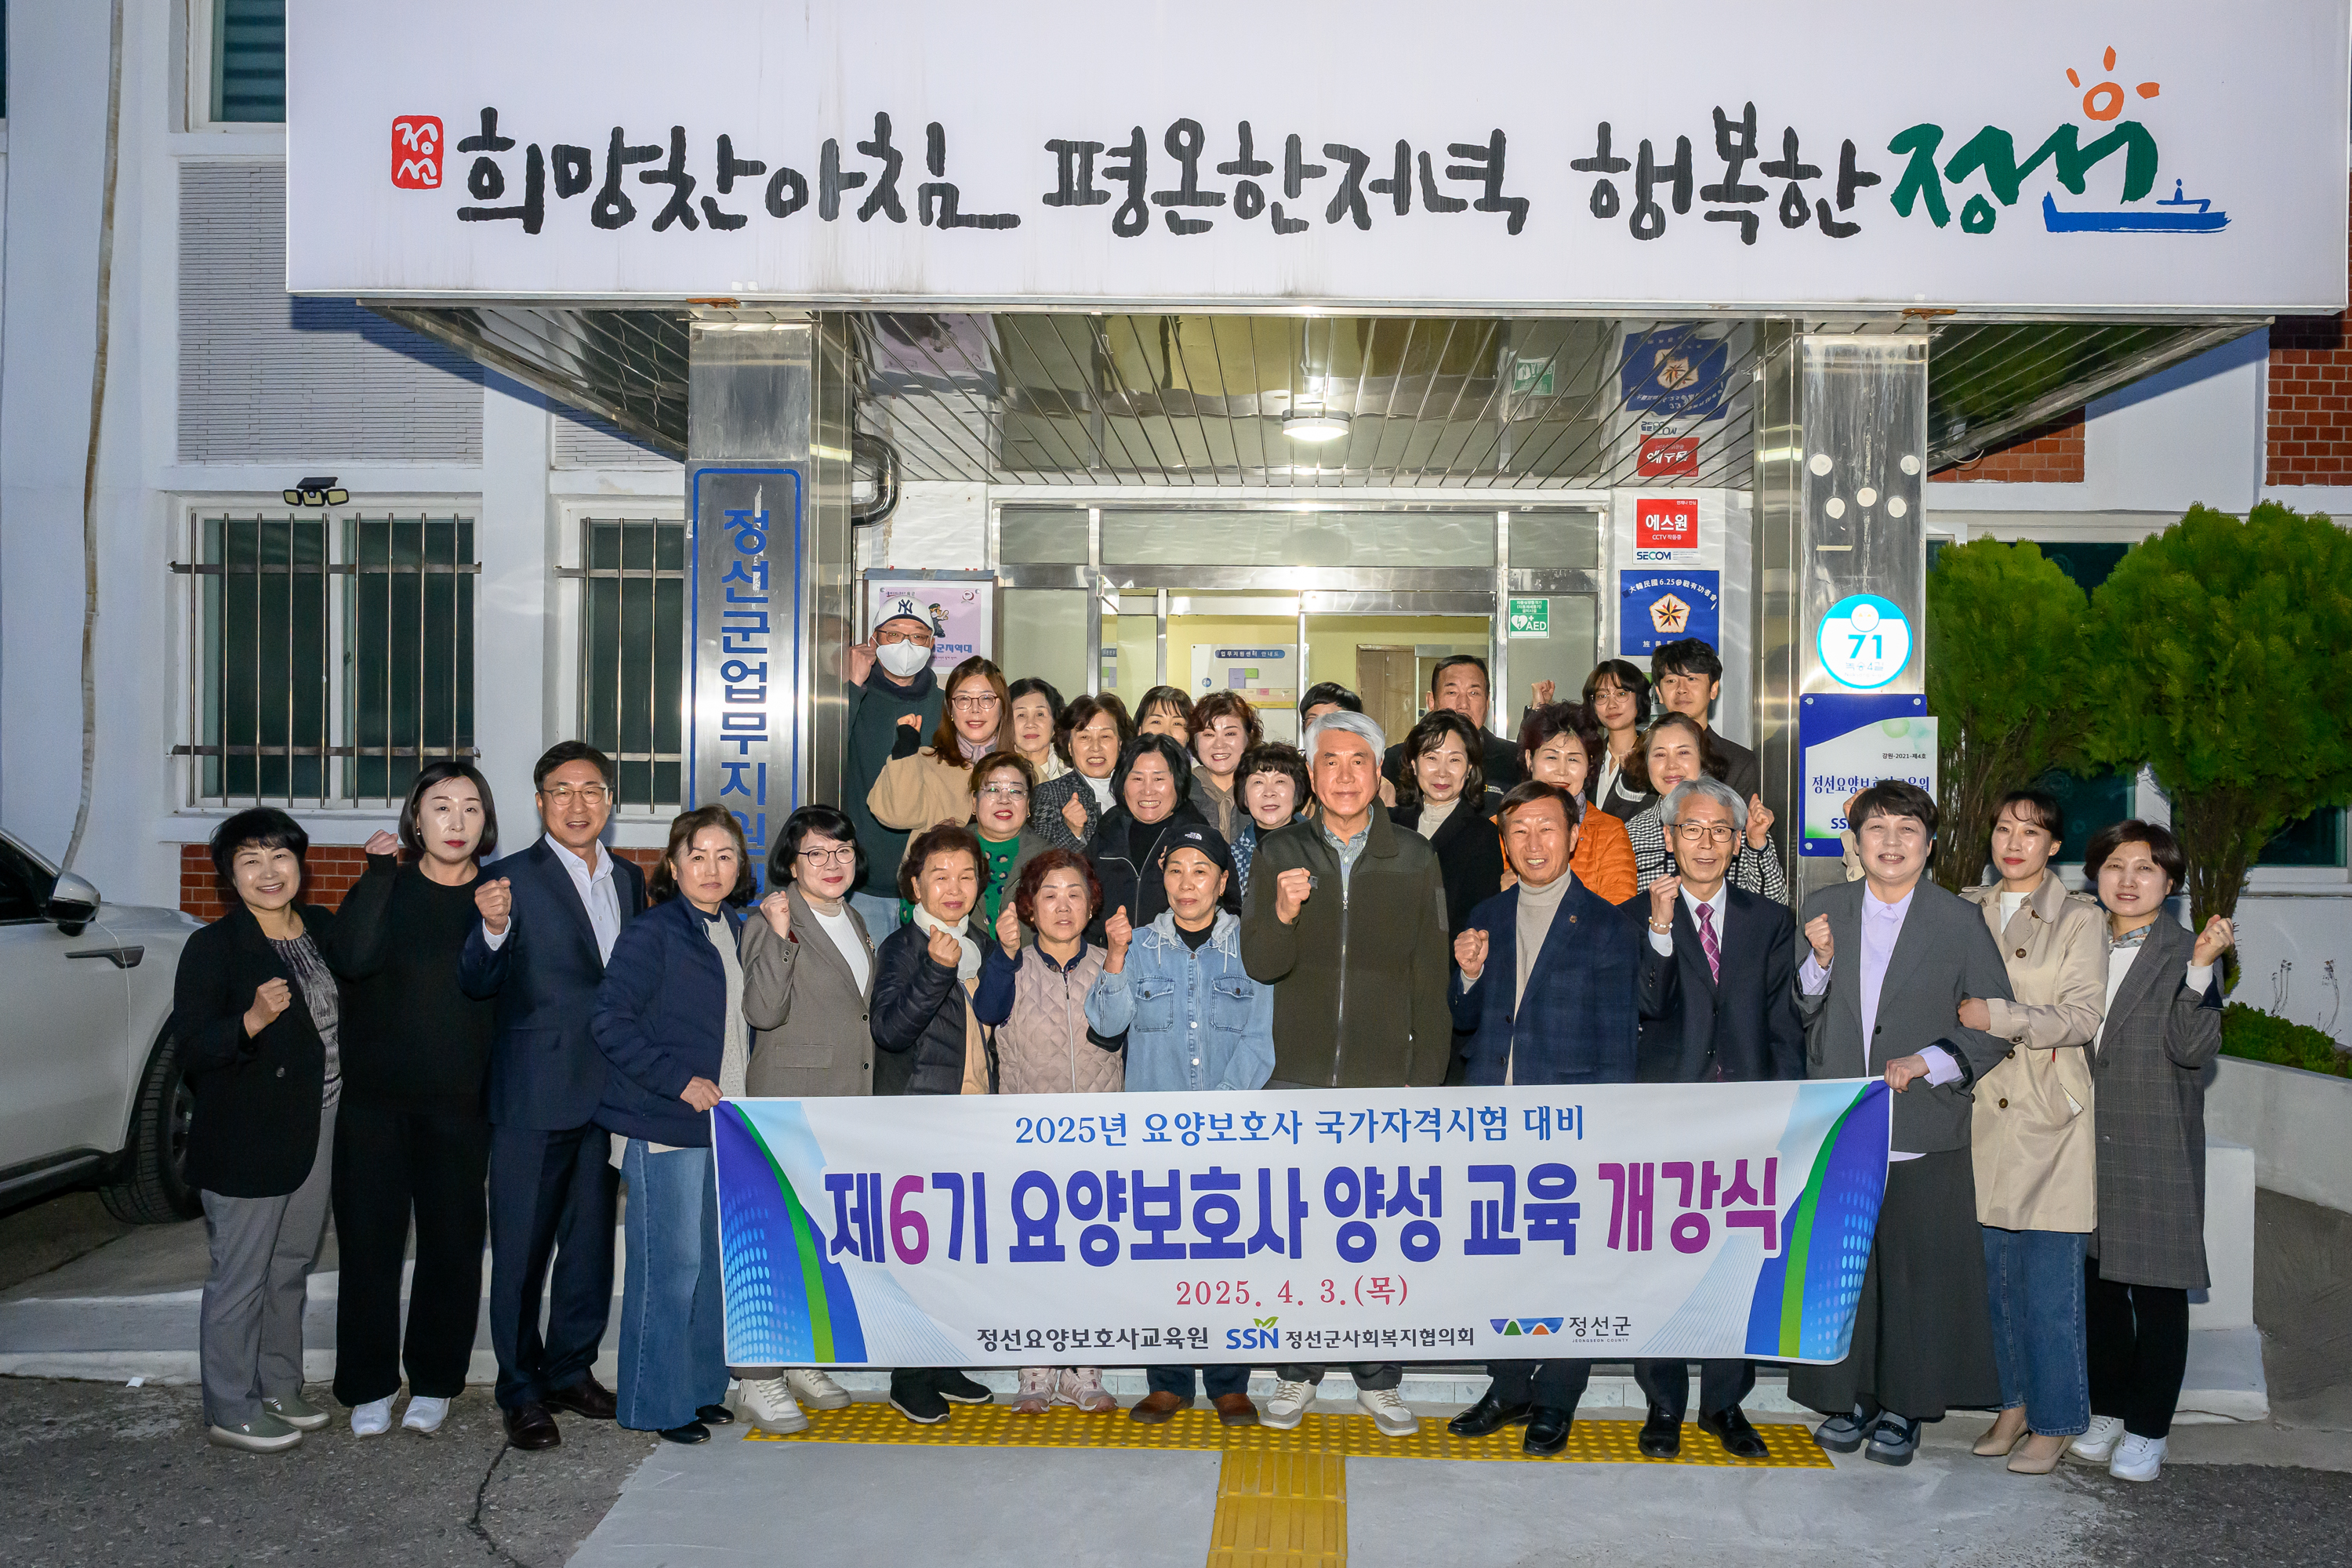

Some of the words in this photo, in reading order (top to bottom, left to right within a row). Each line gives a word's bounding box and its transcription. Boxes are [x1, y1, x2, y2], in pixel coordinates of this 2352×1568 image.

[1645, 514, 1687, 532] 에스원
[1636, 551, 1671, 561] SECOM
[1525, 621, 1547, 631] AED
[1847, 634, 1882, 659] 71
[720, 508, 771, 921] 정선군업무지원
[1831, 818, 1851, 829] SS
[1015, 1112, 1127, 1147] 2025년
[1142, 1109, 1303, 1147] 요양보호사
[1315, 1105, 1507, 1145] 국가자격시험
[1523, 1105, 1584, 1142] 대비
[824, 1171, 989, 1265] 제6기
[1009, 1166, 1308, 1268] 요양보호사
[1323, 1166, 1442, 1264] 양성
[1464, 1163, 1581, 1256] 교육
[1599, 1156, 1779, 1254] 개강식
[1176, 1280, 1261, 1308] 2025.
[1277, 1279, 1304, 1306] 4.
[1320, 1276, 1408, 1306] 3.(목)
[1285, 1327, 1475, 1349] 정선군사회복지협의회
[1569, 1316, 1632, 1338] 정선군
[976, 1327, 1209, 1352] 정선요양보호사교육원
[1225, 1328, 1279, 1350] SSN
